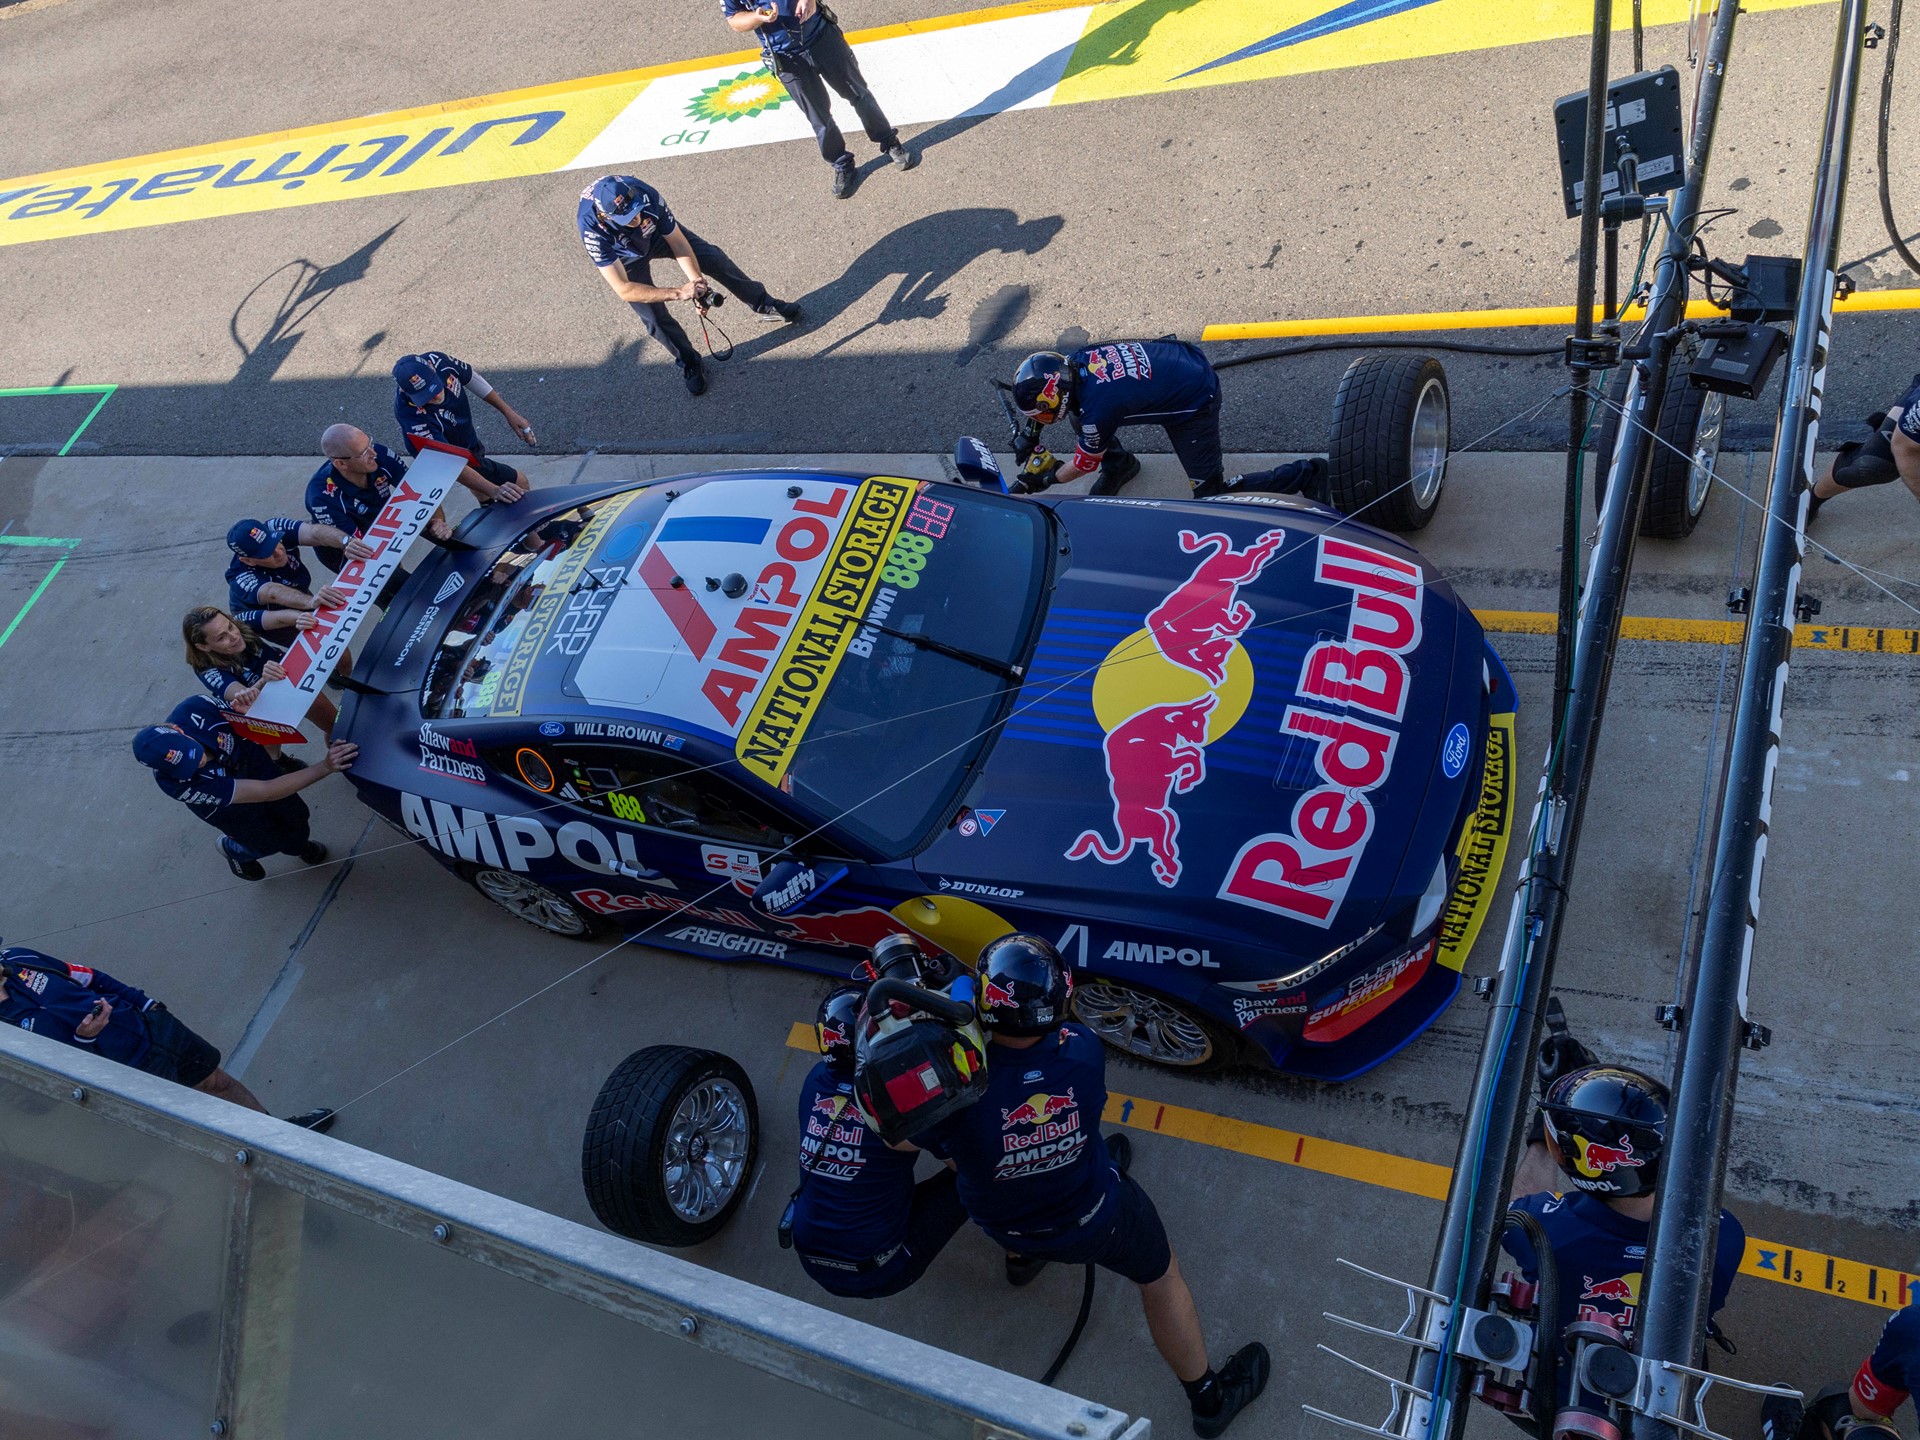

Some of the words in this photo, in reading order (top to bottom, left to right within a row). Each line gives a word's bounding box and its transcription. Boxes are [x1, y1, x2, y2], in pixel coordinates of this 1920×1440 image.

[660, 129, 711, 146] bp
[549, 490, 637, 592] NATIONAL
[303, 480, 423, 655] AMPLIFY
[880, 531, 934, 590] 888
[299, 563, 392, 694] Premium
[387, 486, 444, 554] Fuels
[701, 487, 849, 728] AMPOL
[393, 605, 435, 667] DENNISON
[416, 605, 441, 644] AVERY
[737, 610, 852, 772] NATIONAL
[823, 484, 905, 607] STORAGE
[846, 586, 899, 660] Brown
[498, 595, 556, 710] STORAGE
[221, 712, 297, 735] SUPERCHEAP
[574, 722, 606, 736] WILL
[606, 724, 662, 745] BROWN
[419, 744, 486, 782] Partners
[1445, 734, 1467, 770] Ford
[607, 791, 646, 824] 888
[401, 791, 680, 890] AMPOL
[762, 868, 816, 911] Thrifty
[781, 892, 806, 911] RENTAL
[951, 881, 1024, 899] DUNLOP
[1438, 835, 1496, 954] NATIONAL
[1102, 940, 1221, 969] AMPOL
[1307, 942, 1431, 1026] SUPERCHEAP
[1036, 1014, 1054, 1023] Toby
[1236, 1003, 1308, 1029] Partners
[994, 1143, 1084, 1179] RACING
[995, 1130, 1088, 1168] AMPOL
[1571, 1176, 1622, 1192] AMPOL
[1793, 1270, 1803, 1283] 3
[1837, 1280, 1846, 1293] 2
[1882, 1290, 1887, 1303] 1
